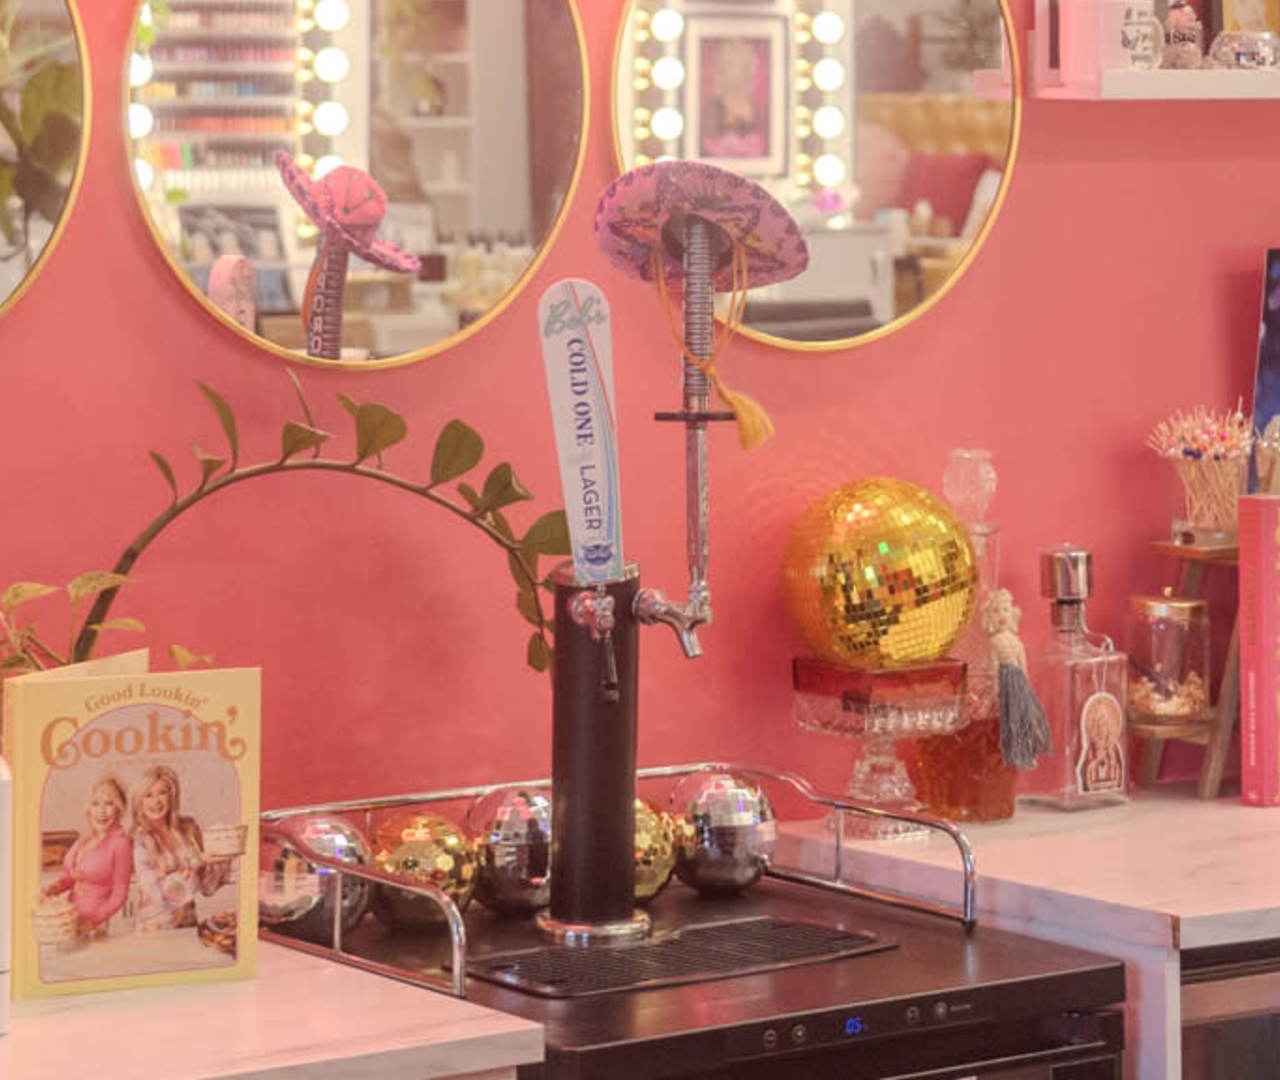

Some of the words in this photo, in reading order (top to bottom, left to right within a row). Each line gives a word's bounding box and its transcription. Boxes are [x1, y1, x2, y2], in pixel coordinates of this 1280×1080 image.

[566, 337, 589, 396] COLD
[573, 400, 595, 447] ONE
[579, 463, 603, 531] LAGER
[84, 683, 134, 714] Good
[138, 681, 210, 709] Lookin'
[39, 705, 249, 770] Cookin'
